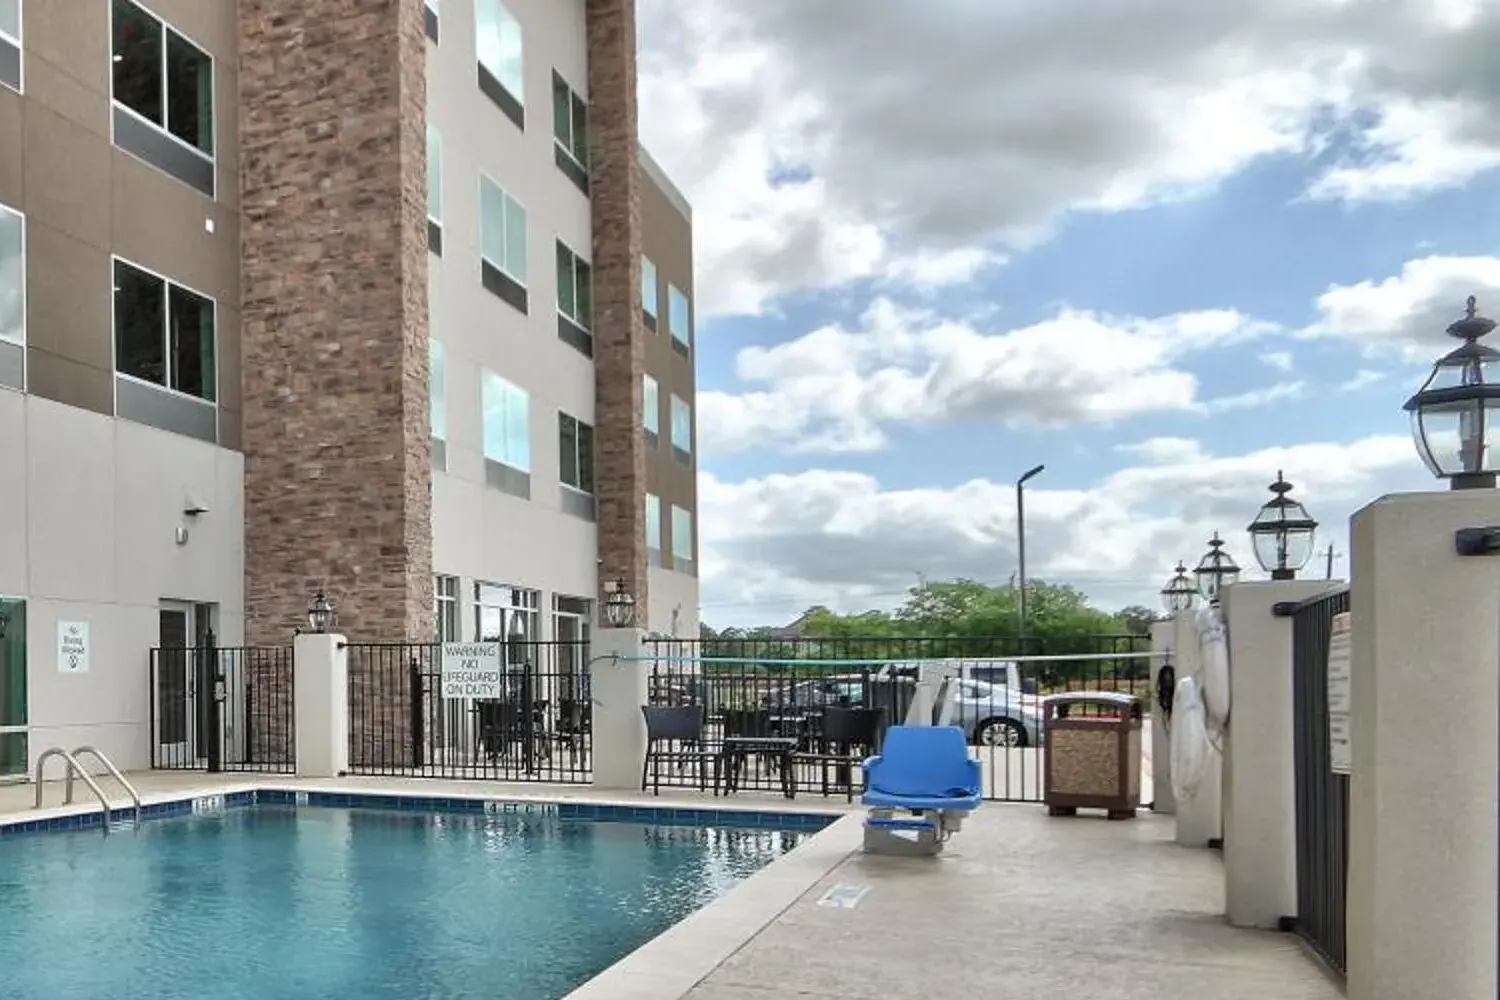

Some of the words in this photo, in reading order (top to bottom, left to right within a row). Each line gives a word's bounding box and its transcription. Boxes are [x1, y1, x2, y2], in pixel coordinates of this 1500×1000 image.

[444, 645, 497, 657] WARNING
[461, 659, 479, 669] NO
[447, 683, 463, 695] ON
[465, 683, 496, 696] DUTY
